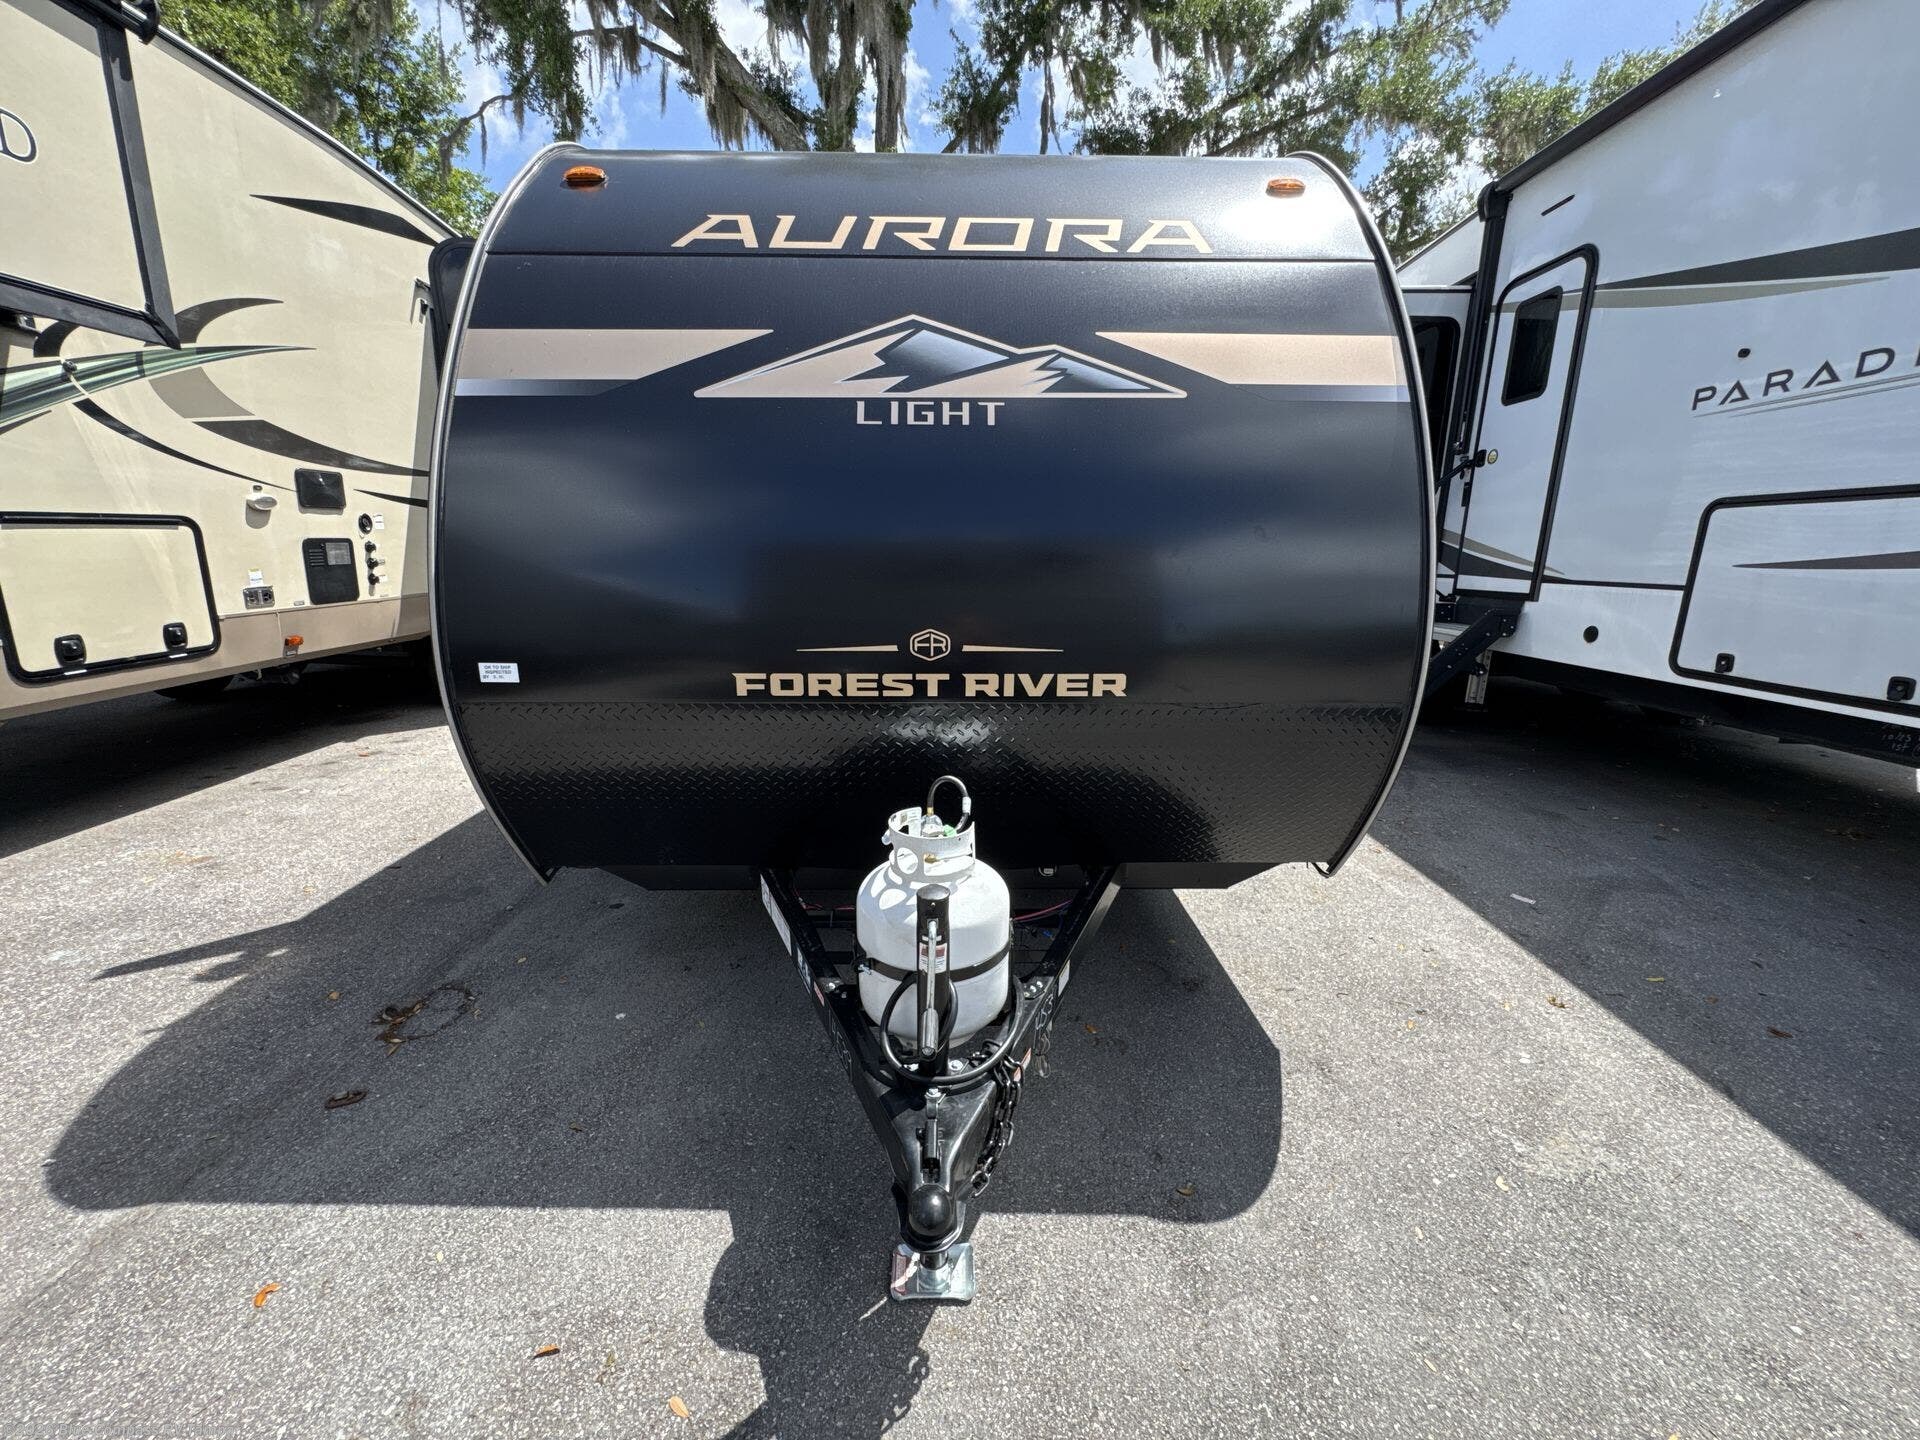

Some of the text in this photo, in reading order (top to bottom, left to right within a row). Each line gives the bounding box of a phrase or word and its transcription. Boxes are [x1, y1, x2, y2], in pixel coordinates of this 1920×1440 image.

[670, 214, 1213, 254] AURORA
[856, 401, 1005, 426] LIGHT
[731, 672, 1128, 698] FOREST RIVER
